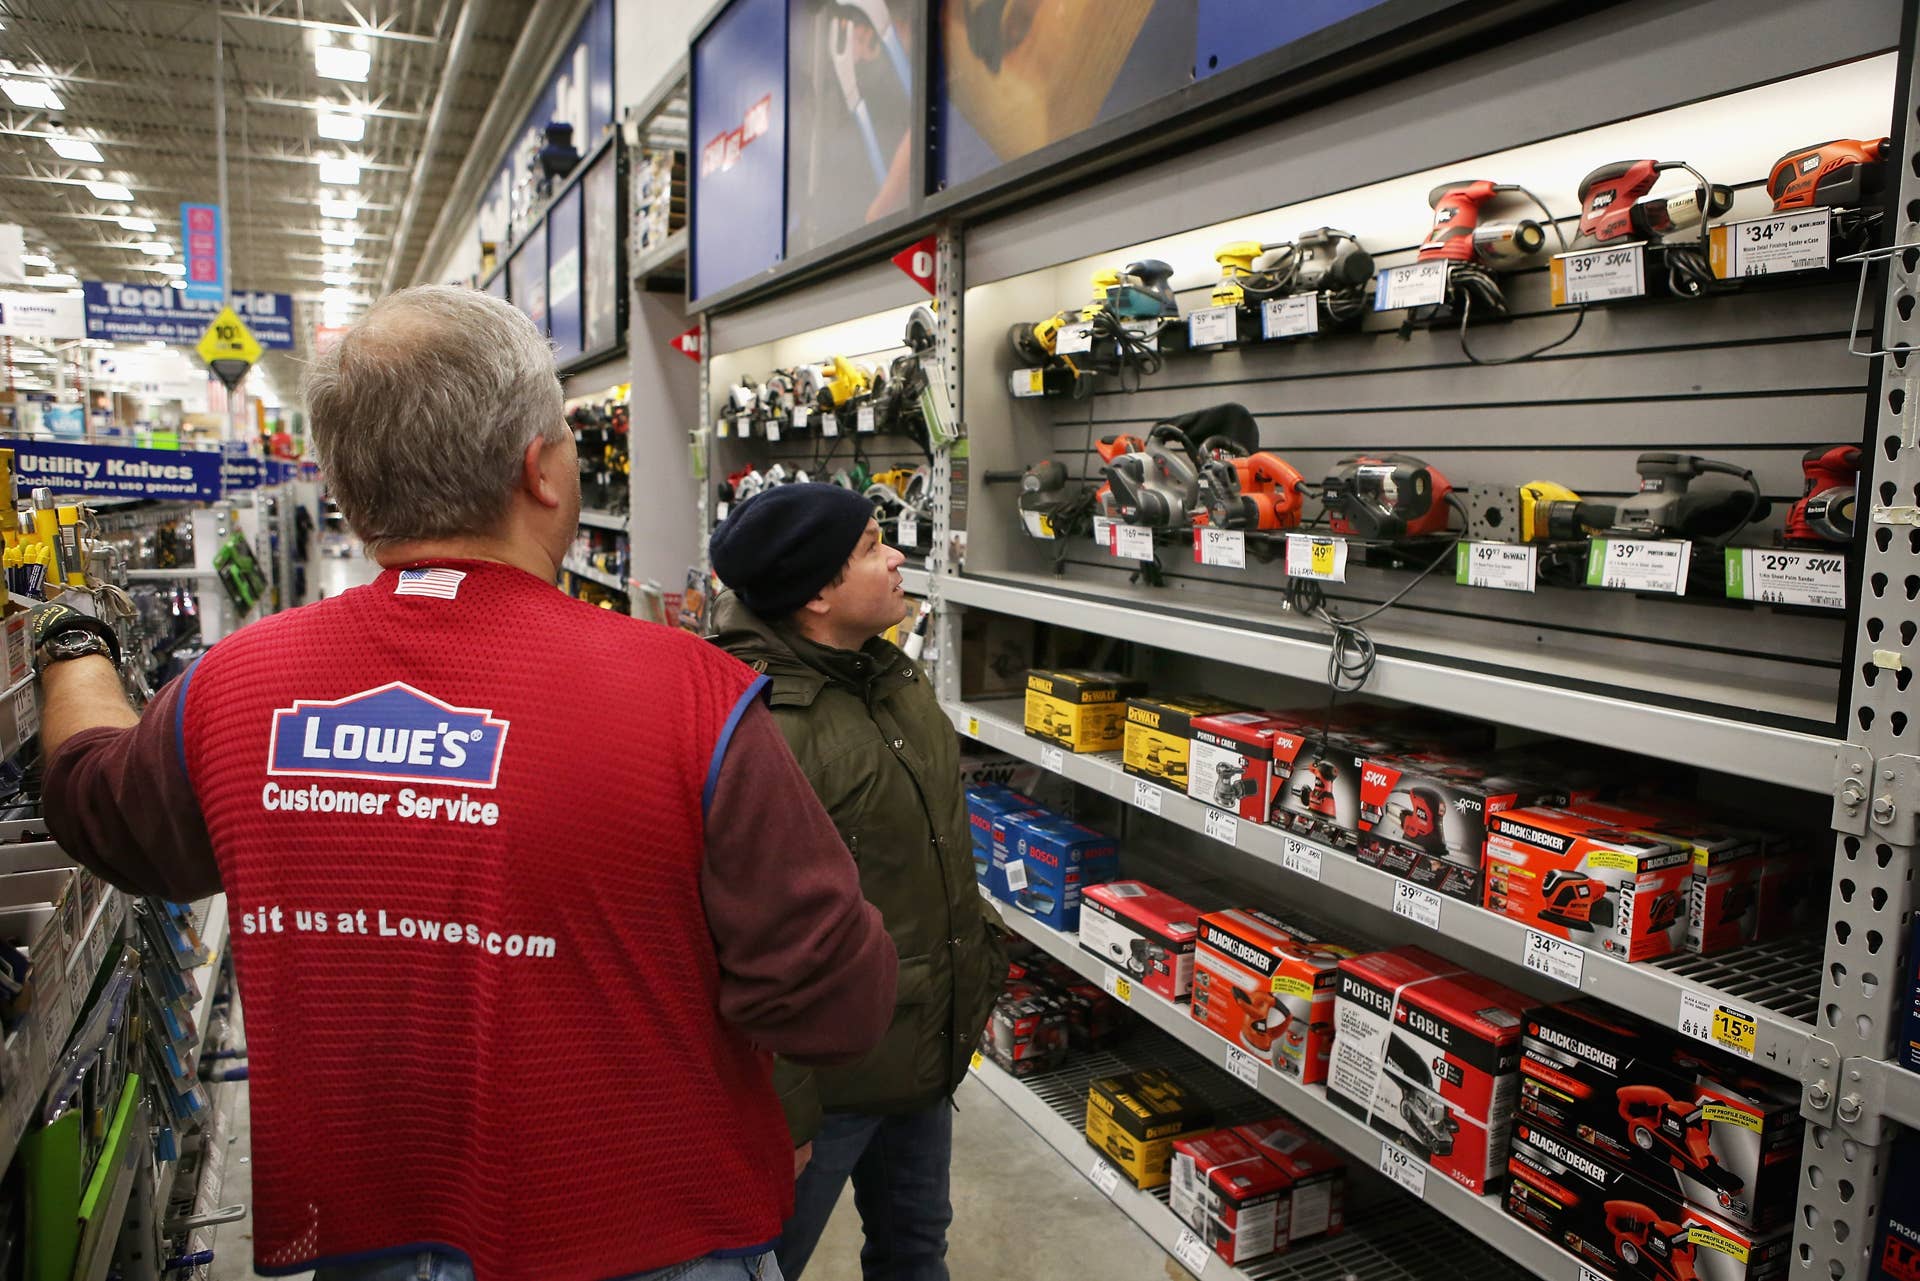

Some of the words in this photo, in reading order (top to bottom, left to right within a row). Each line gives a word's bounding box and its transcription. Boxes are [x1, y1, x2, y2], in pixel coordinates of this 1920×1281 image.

[1605, 252, 1631, 267] SKIL
[102, 283, 174, 308] Tool
[89, 319, 104, 331] El
[157, 323, 175, 335] de
[681, 335, 698, 352] N
[19, 454, 100, 479] Utility
[107, 459, 193, 481] Knives
[84, 479, 116, 491] para
[118, 481, 144, 492] uso
[146, 480, 197, 495] general
[1806, 558, 1842, 575] SKIL
[1128, 706, 1161, 728] DEWALT
[302, 716, 470, 768] LOWE'S
[1277, 737, 1294, 749] SKIL
[1364, 771, 1388, 787] SKIL
[263, 782, 390, 815] Customer
[397, 789, 499, 825] Service
[969, 813, 991, 832] BOSCH
[1500, 821, 1564, 850] BLACK&DECKER
[1029, 846, 1059, 868] BOSCH
[296, 909, 328, 933] us
[337, 909, 368, 934] at
[379, 909, 556, 958] Lowes.com
[1208, 928, 1271, 972] BLACK&DECKER
[1343, 978, 1392, 1013] PORTER
[1409, 1010, 1450, 1044] CABLE
[1540, 1026, 1617, 1071] BLACK&DECKER
[1438, 1062, 1446, 1077] 8
[1717, 1109, 1738, 1120] PROFILE
[1738, 1113, 1758, 1126] DESIGN
[1529, 1130, 1607, 1183] BLACK&DECKER
[1691, 1231, 1703, 1239] LOW
[1703, 1234, 1724, 1247] PROFILE
[1724, 1241, 1744, 1255] DESIGN
